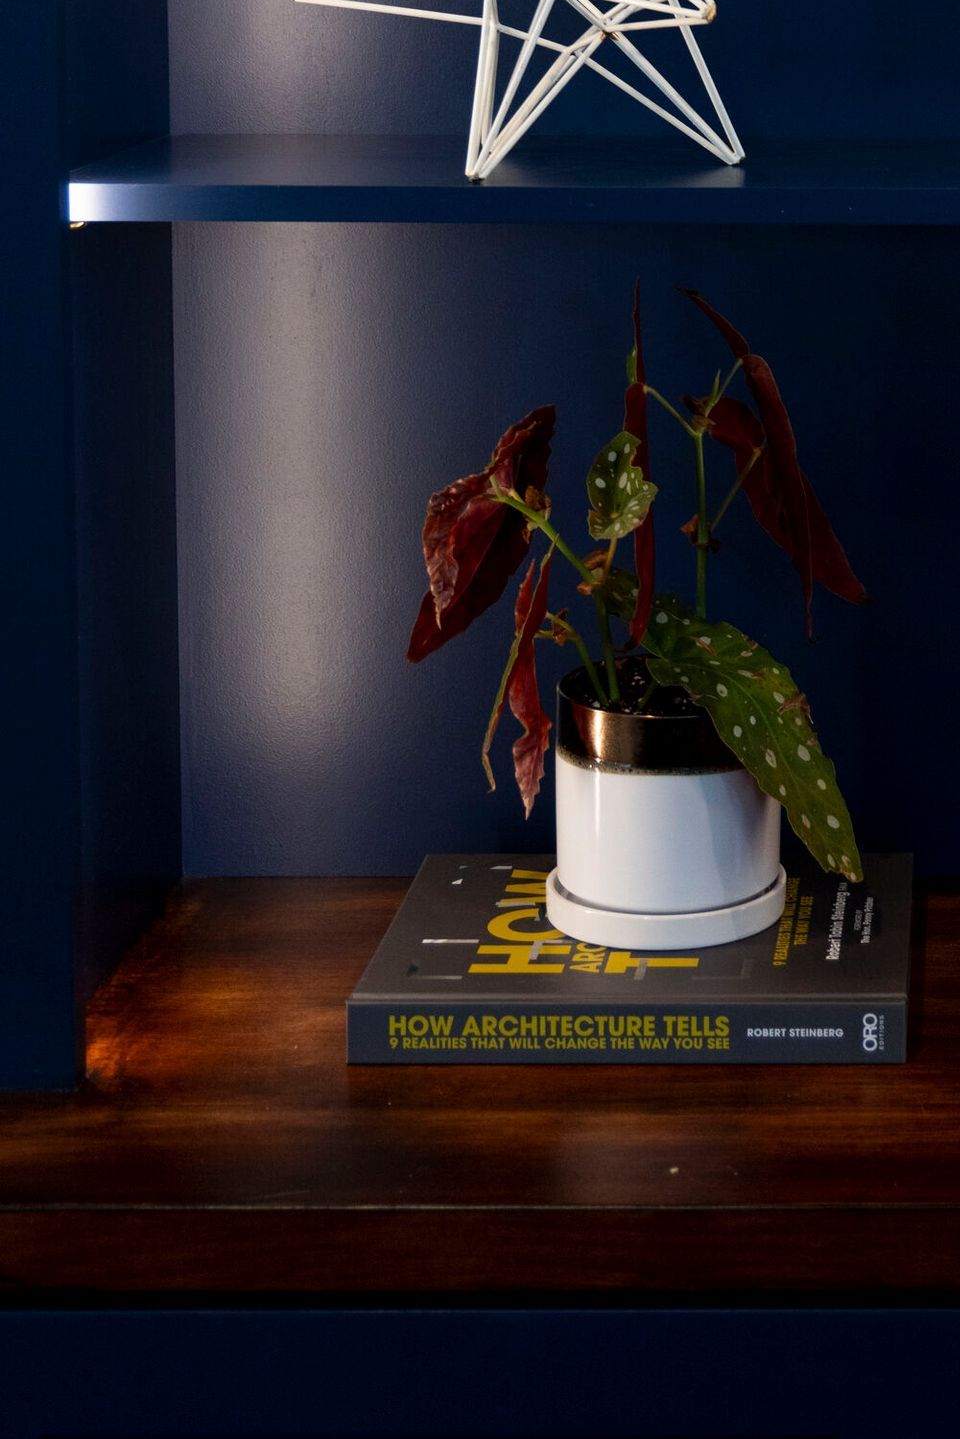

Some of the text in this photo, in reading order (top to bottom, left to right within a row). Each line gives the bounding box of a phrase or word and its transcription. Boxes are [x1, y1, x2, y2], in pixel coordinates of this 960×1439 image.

[830, 891, 851, 921] Steinberg
[825, 939, 841, 960] Robert
[388, 1015, 730, 1037] HOW ARCHITECTURE TELLS
[746, 1028, 844, 1038] ROBERT STEINBERG
[862, 1013, 878, 1051] ORO
[389, 1037, 730, 1050] 9 REALITIES THAT WILL CHANGE THE WAY YOU SEE
